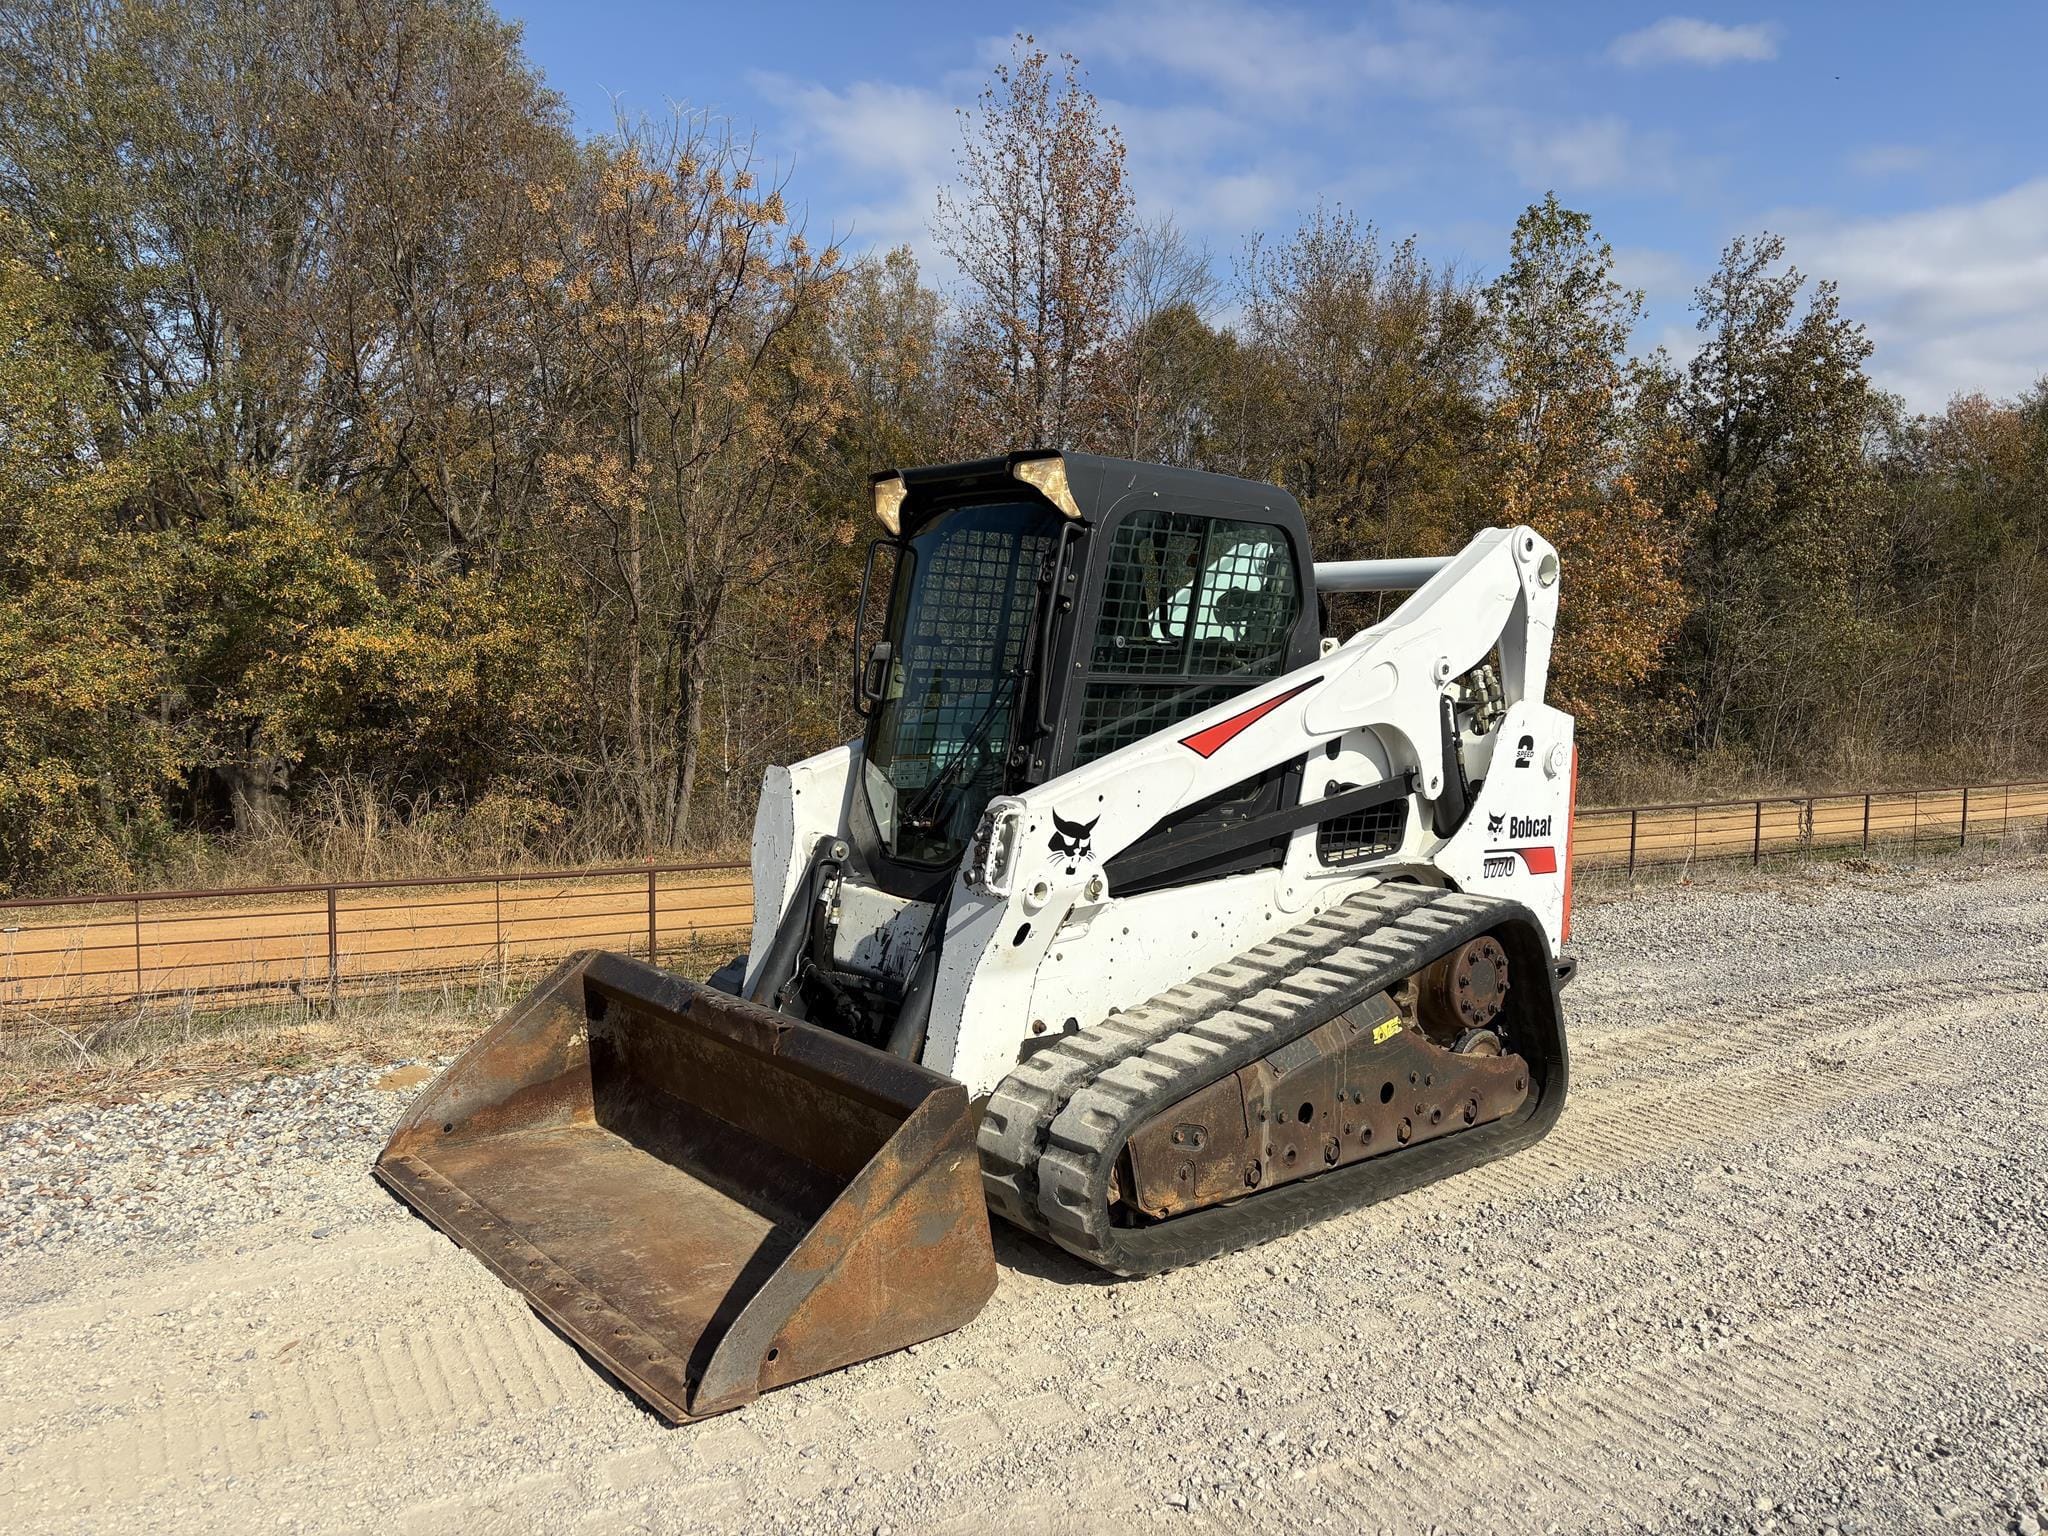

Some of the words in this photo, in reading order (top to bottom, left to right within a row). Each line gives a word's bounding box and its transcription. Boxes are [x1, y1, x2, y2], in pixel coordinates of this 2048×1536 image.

[1515, 735, 1534, 768] 2
[1516, 750, 1534, 758] SPEED
[1510, 815, 1551, 839] Bobcat
[1484, 856, 1515, 878] T770
